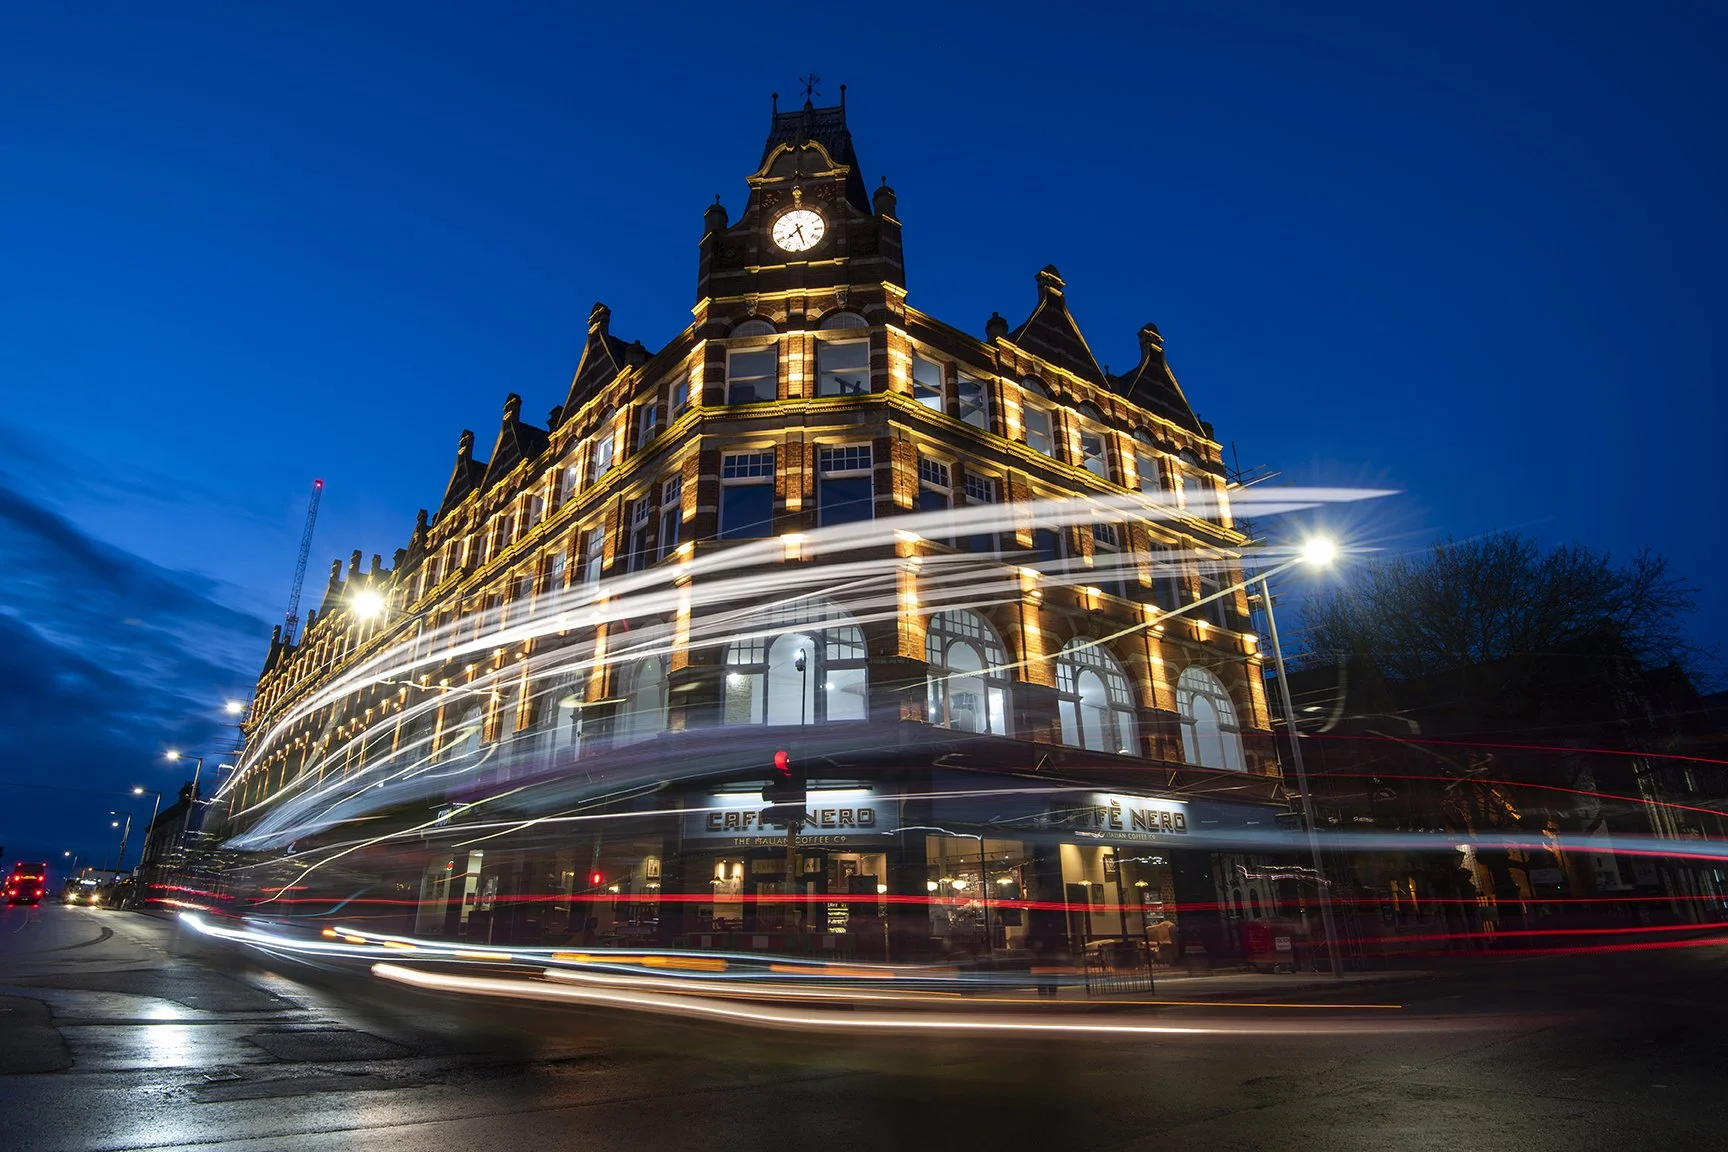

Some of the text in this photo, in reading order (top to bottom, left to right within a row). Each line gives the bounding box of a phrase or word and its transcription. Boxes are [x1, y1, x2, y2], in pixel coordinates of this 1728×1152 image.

[802, 808, 875, 828] NERO
[1130, 807, 1186, 832] NERO
[733, 837, 751, 845] THE
[795, 836, 829, 844] COFFEE
